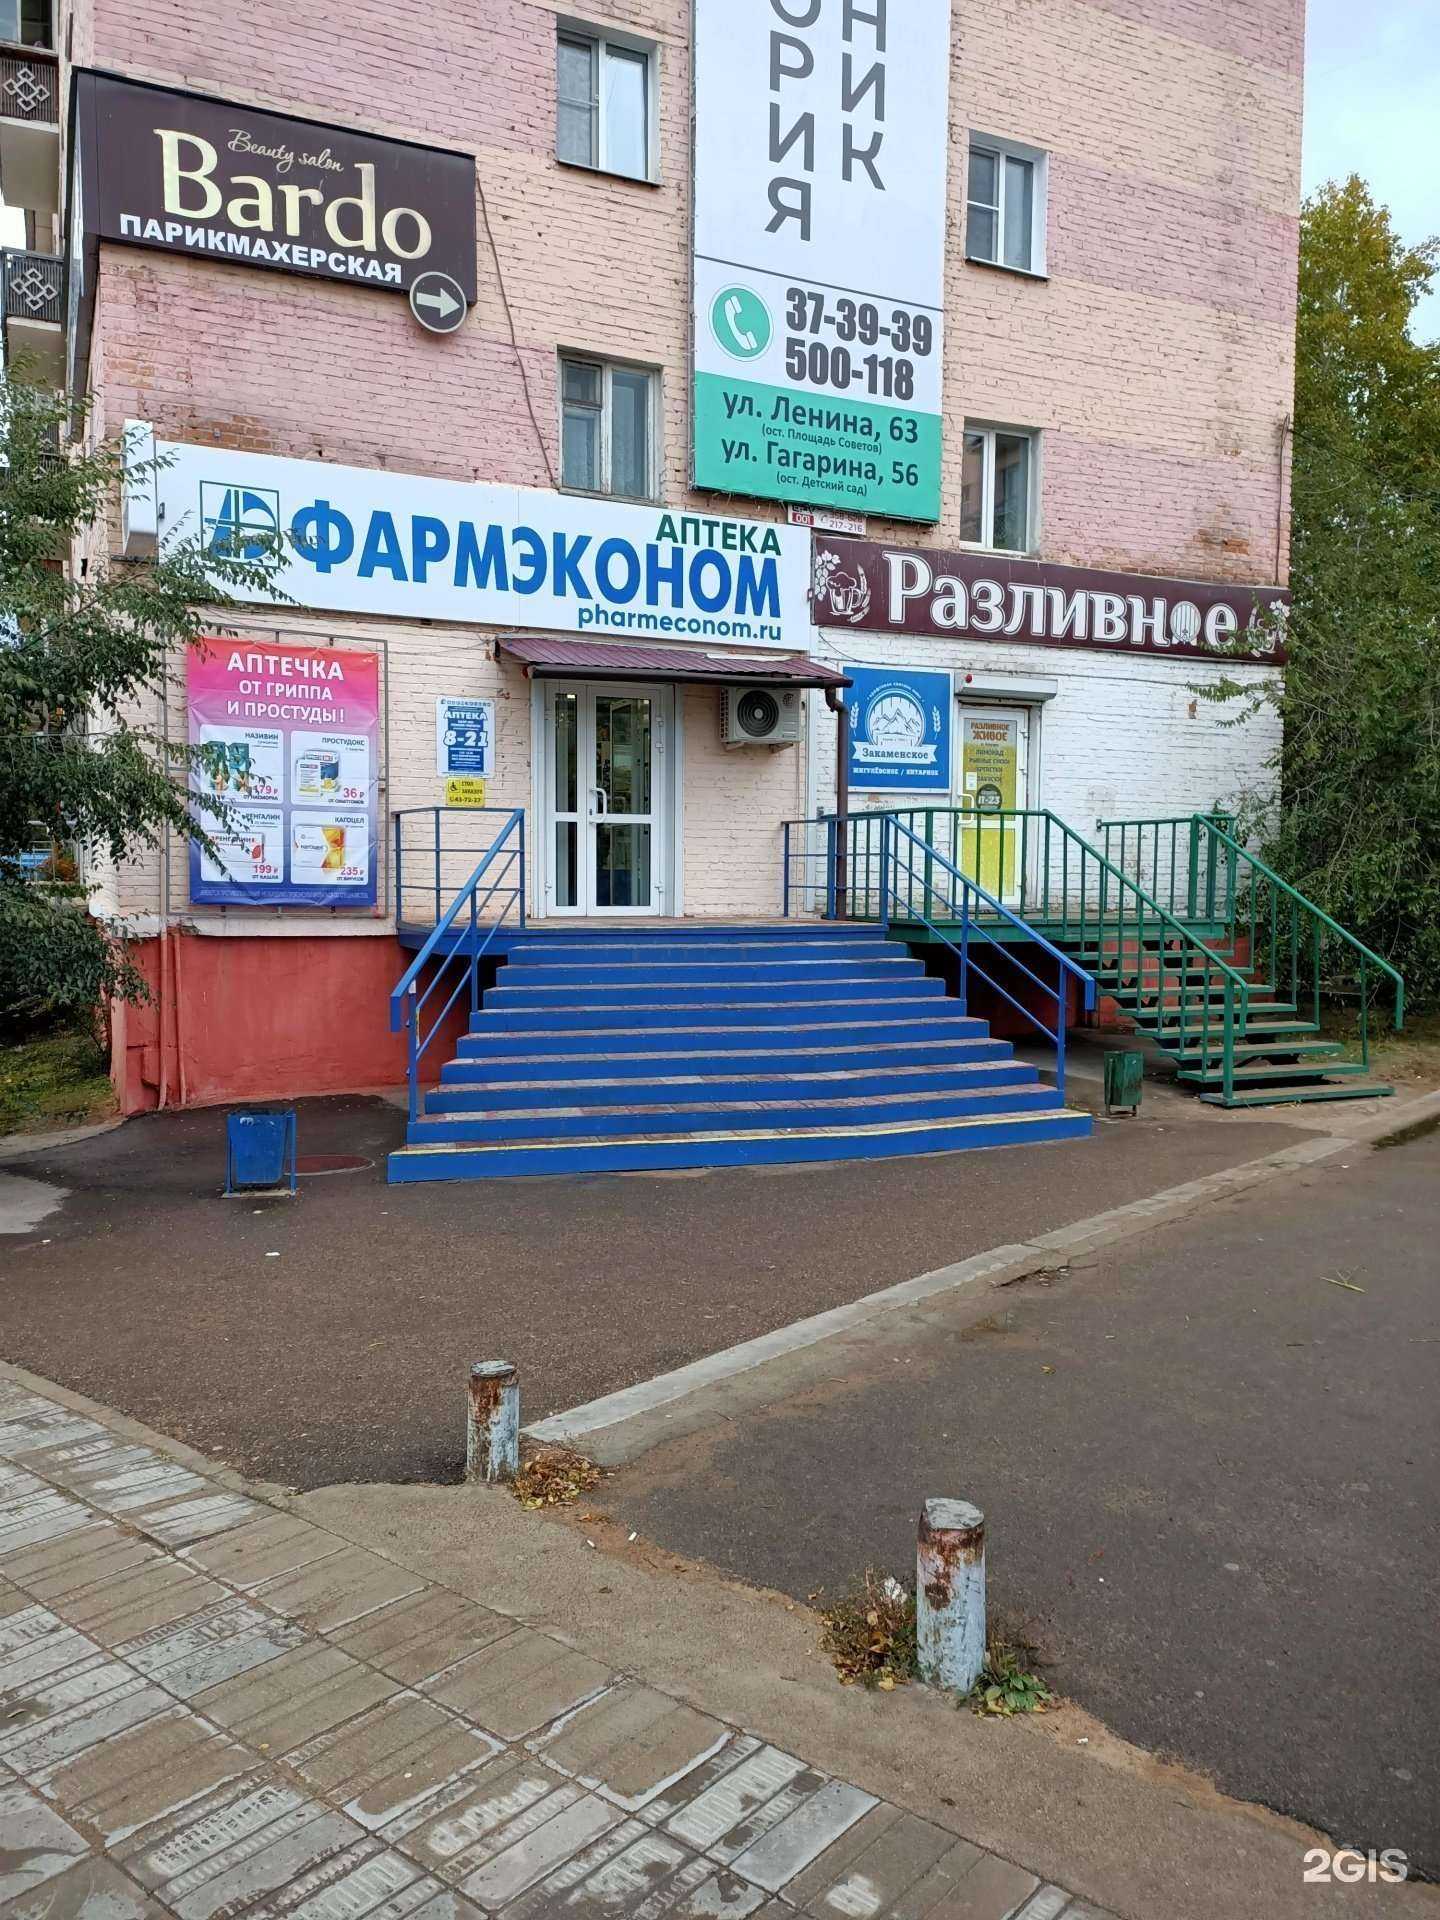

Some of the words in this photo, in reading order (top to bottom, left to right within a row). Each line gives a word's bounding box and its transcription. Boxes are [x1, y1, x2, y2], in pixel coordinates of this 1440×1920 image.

[227, 128, 295, 174] Beauty
[298, 147, 345, 173] salon
[153, 128, 433, 260] Bardo
[119, 213, 403, 284] ПАРИКМАХЕРСКАЯ
[785, 286, 933, 357] 37-39-39
[785, 336, 914, 401] 500-118
[722, 391, 763, 419] ул.
[770, 395, 881, 442] Ленина,
[888, 415, 919, 444] 63
[761, 423, 786, 439] (ост.
[787, 428, 836, 447] Площадь
[838, 436, 882, 456] Советов)
[721, 438, 758, 464] ул.
[766, 440, 884, 487] Гагарина,
[890, 461, 919, 487] 56
[775, 471, 800, 486] (ост.
[801, 475, 844, 493] Детский
[846, 481, 868, 497] сад)
[655, 513, 782, 556] АПТЕКА
[290, 498, 782, 619] ФАРМЭКОНОМ
[881, 550, 1238, 649] Разливное
[577, 604, 782, 641] pharmeconom.ru
[227, 651, 345, 682] АПТЕЧКА
[239, 679, 262, 696] ОТ
[266, 681, 333, 701] ГРИППА
[226, 700, 239, 716] И
[443, 710, 488, 721] АПТЕКА
[443, 730, 489, 748] 8-21
[972, 730, 1008, 742] ЖИВОЕ
[343, 787, 358, 799] 36
[253, 864, 272, 874] 199
[340, 866, 358, 876] 235
